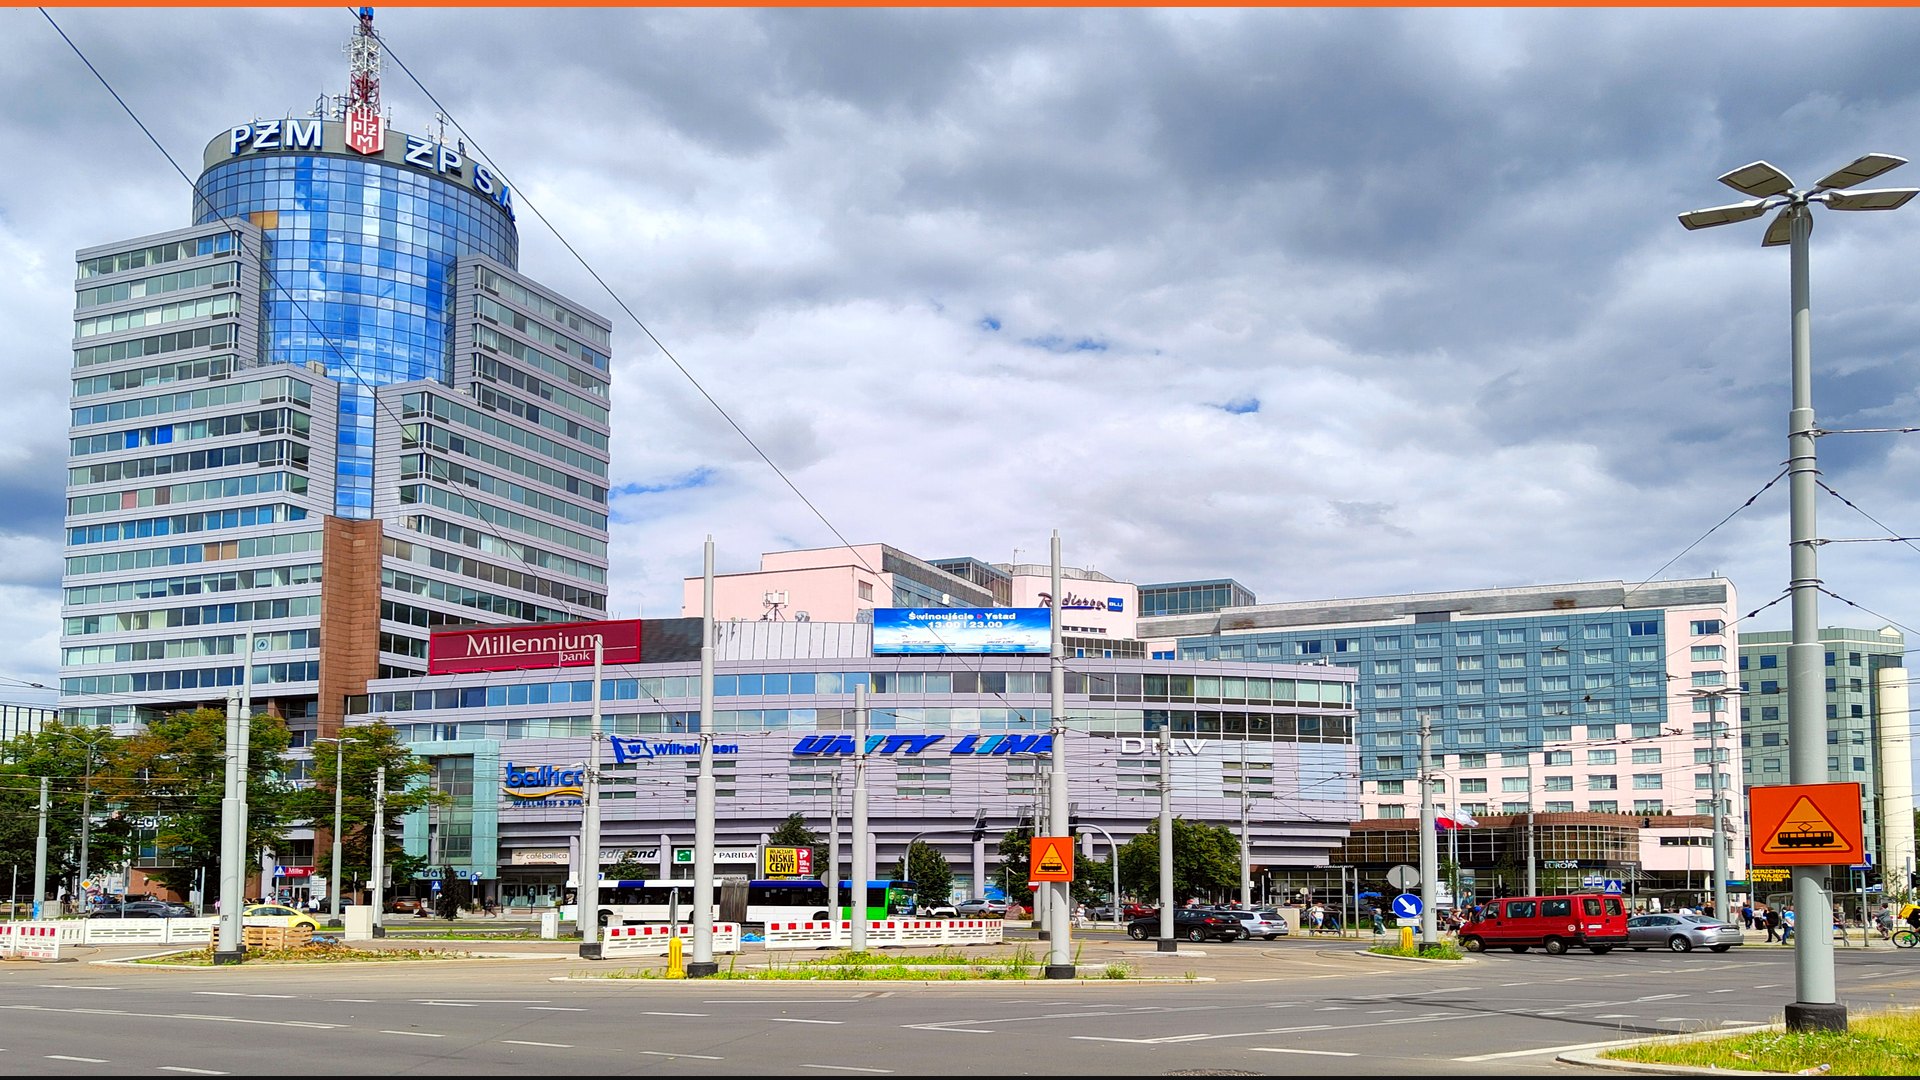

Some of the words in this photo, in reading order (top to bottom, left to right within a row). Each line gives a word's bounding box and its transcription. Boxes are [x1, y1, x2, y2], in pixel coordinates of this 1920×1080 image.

[1038, 591, 1106, 609] Rdisson
[1109, 600, 1123, 608] BLU
[985, 612, 1016, 620] Ystad
[928, 621, 960, 629] 13.00
[969, 621, 1003, 629] 23.00
[466, 632, 604, 656] Millennium
[560, 650, 591, 662] bank
[653, 743, 739, 755] Wilhelsen
[792, 735, 945, 755] UNITY
[1121, 738, 1208, 756] DNV
[769, 854, 794, 863] NISKIE
[769, 863, 794, 872] CENY!
